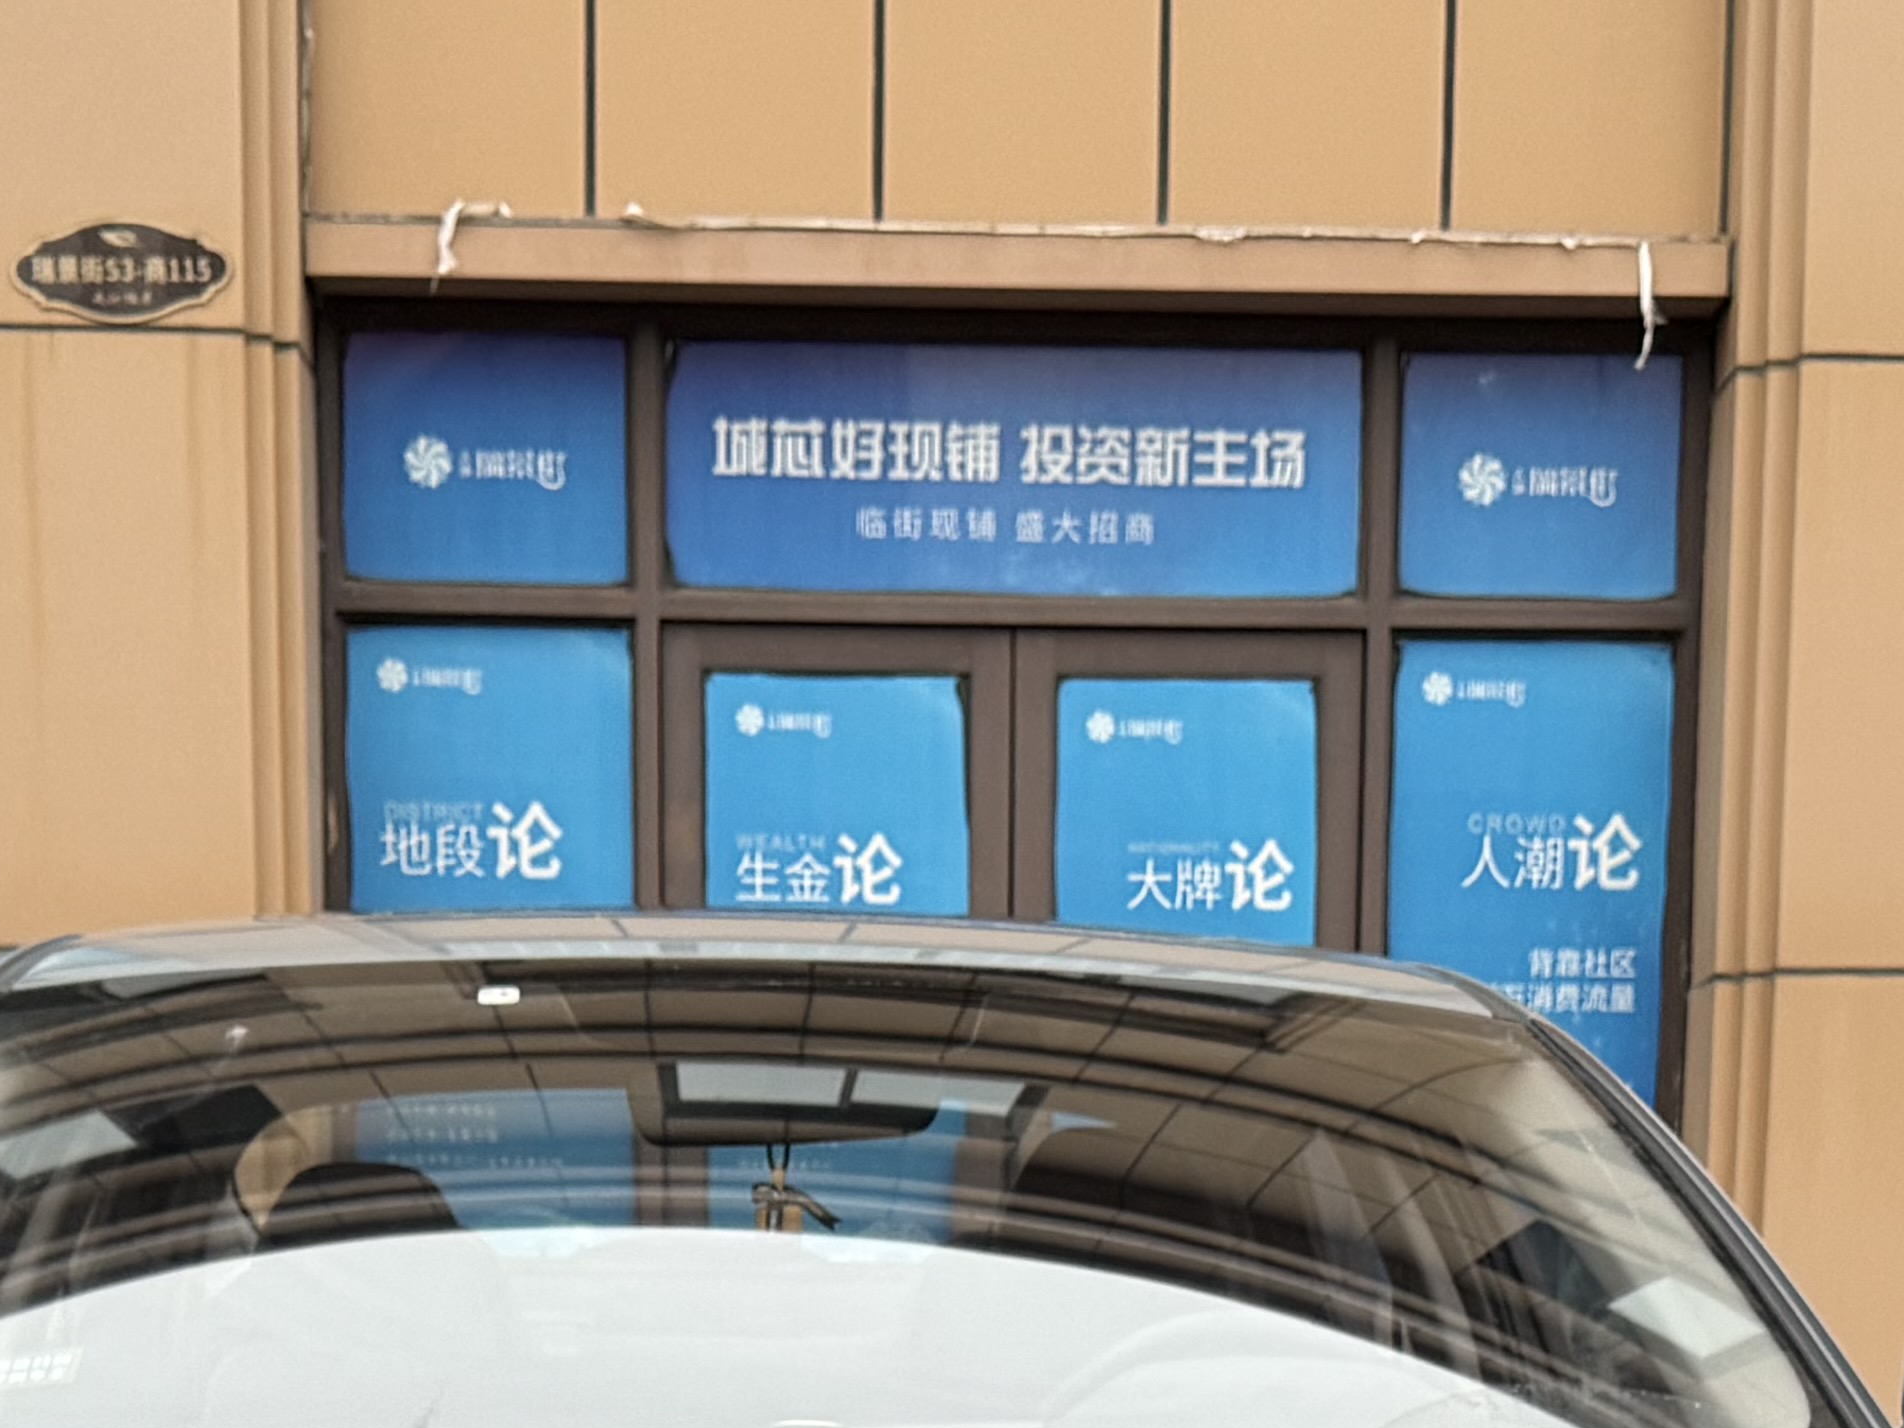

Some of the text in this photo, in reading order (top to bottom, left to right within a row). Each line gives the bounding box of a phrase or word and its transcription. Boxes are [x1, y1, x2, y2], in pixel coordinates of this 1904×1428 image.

[712, 415, 1306, 489] 城芯好现铺 投资新主场
[855, 506, 1155, 546] 临街现铺 盛大招商
[380, 800, 563, 880] 地段论
[1461, 811, 1643, 891] 人潮论
[1467, 812, 1567, 835] CROWD
[735, 831, 903, 905] 生金论
[1127, 838, 1294, 912] 大牌论
